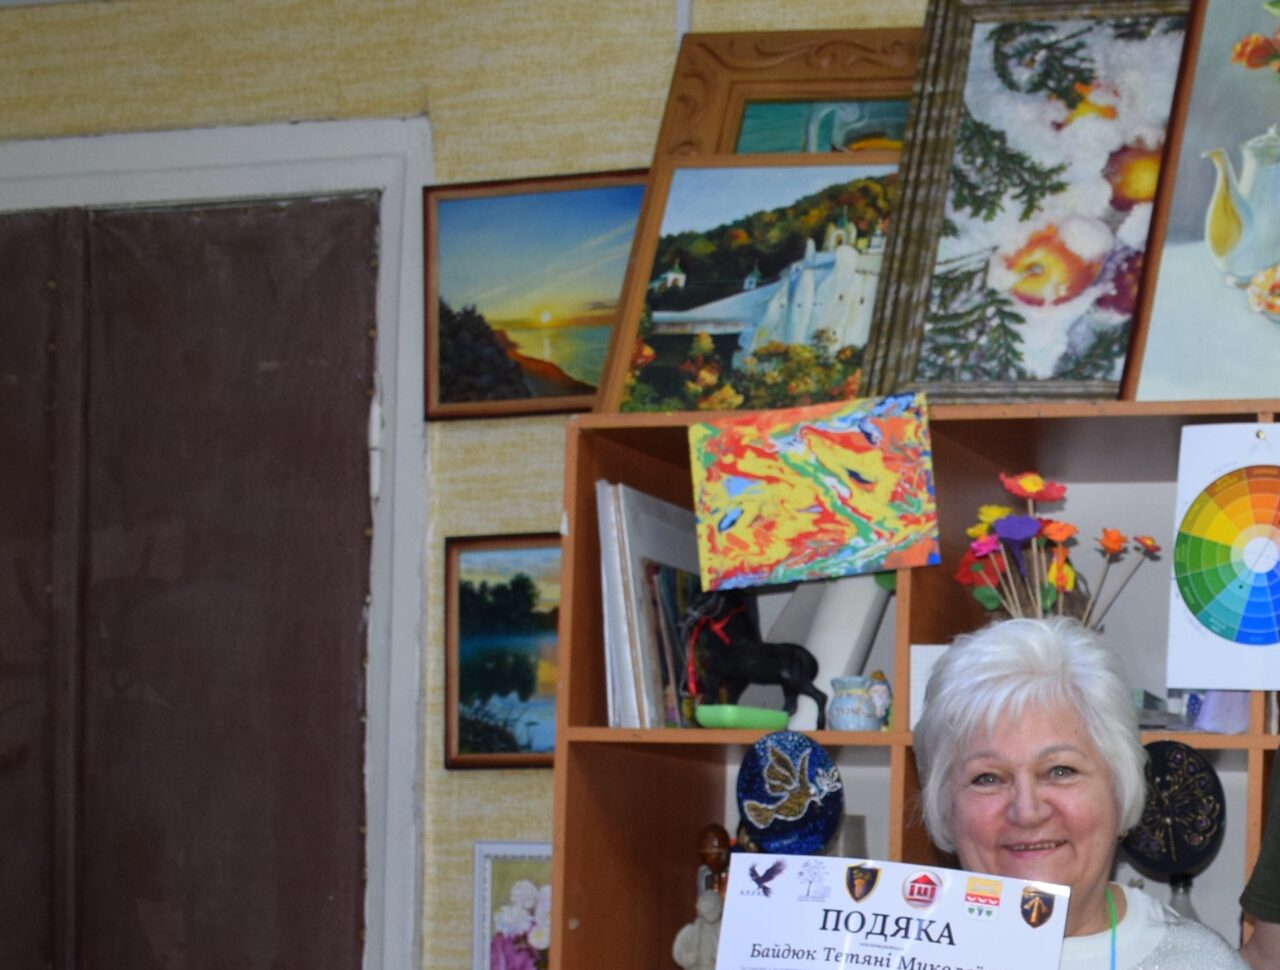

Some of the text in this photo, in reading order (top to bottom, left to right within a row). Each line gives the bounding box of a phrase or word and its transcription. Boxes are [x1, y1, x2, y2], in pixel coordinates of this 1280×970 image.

[819, 908, 956, 946] ПОДЯКА
[750, 943, 817, 961] Байдюк
[823, 947, 892, 969] Тетяні
